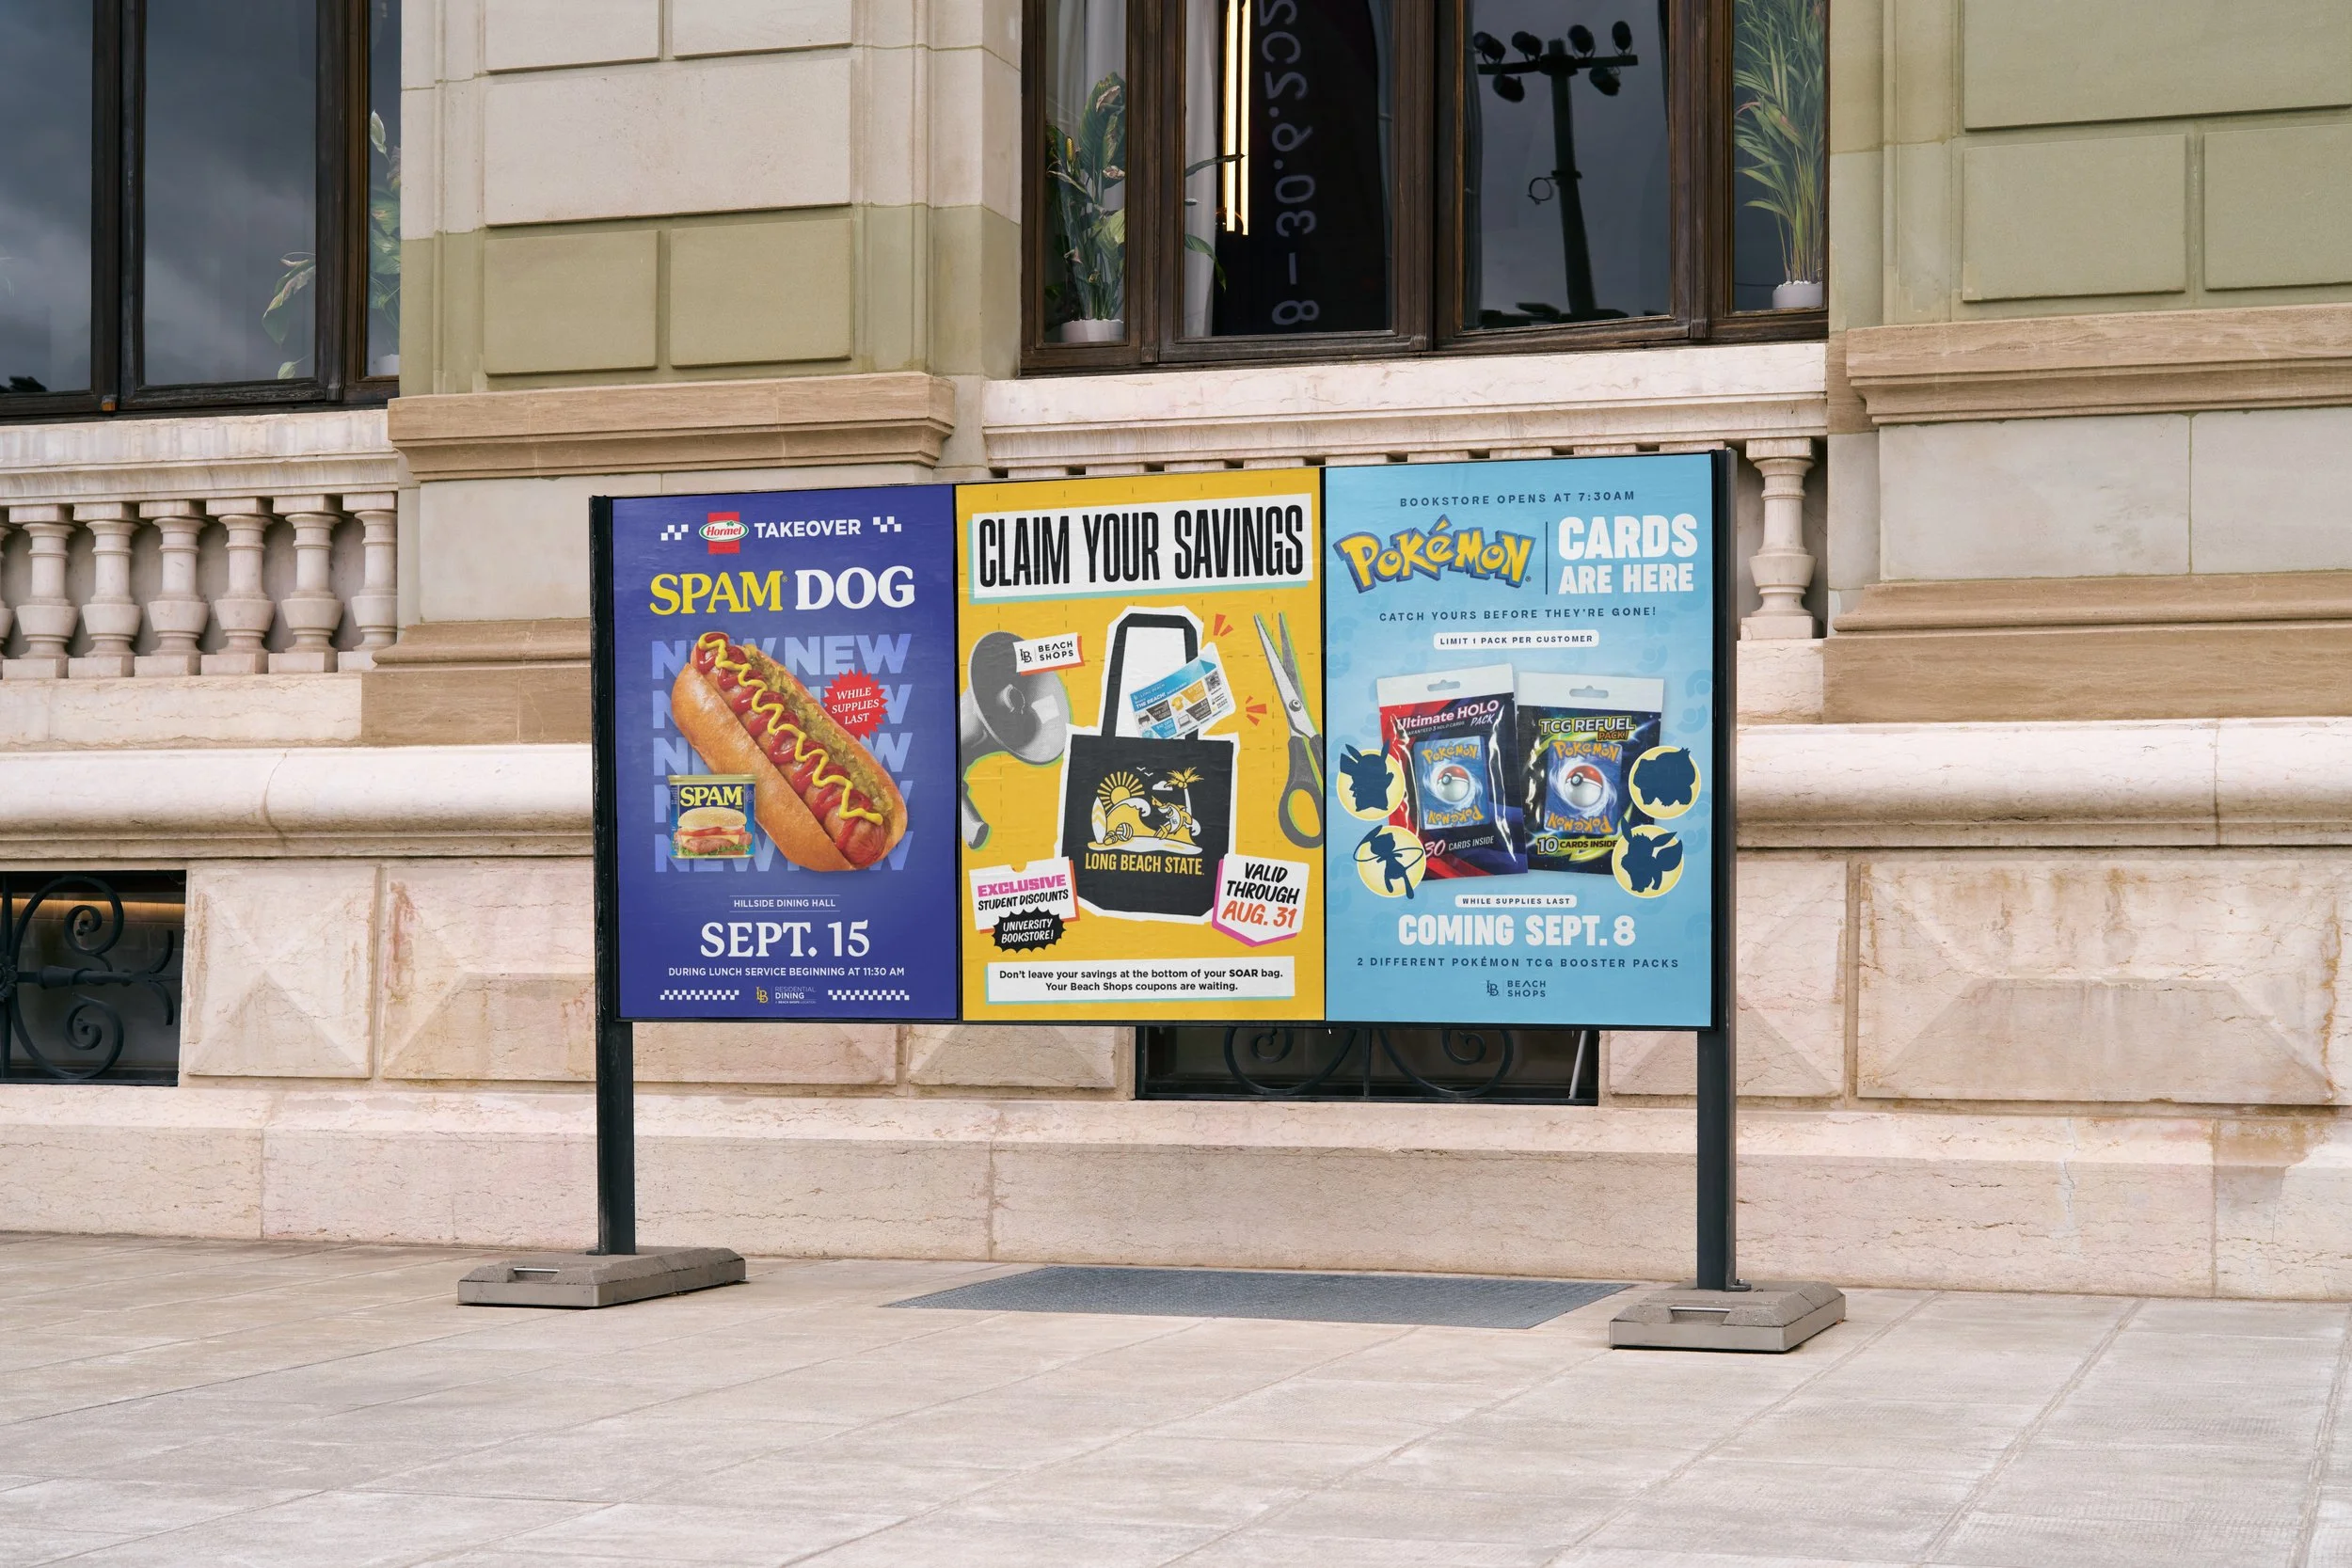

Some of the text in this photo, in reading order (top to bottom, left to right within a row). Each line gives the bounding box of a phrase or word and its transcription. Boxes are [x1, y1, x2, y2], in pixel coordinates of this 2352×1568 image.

[1400, 490, 1634, 507] BOOKSTORE OPENS AT 7:30AM
[707, 519, 861, 539] Hormel TAKEOVER
[1558, 513, 1698, 561] CARDS
[979, 504, 1303, 588] CLAIM YOUR SAVINGS
[1558, 562, 1694, 594] ARE HERE
[795, 565, 915, 610] DOG
[1379, 612, 1424, 622] CATCH
[1431, 610, 1477, 621] YOURS
[1484, 610, 1537, 620] BEFORE
[1612, 607, 1656, 617] GONE!
[785, 633, 912, 675] NEW
[1038, 641, 1073, 653] BEACH
[1040, 649, 1073, 661] SHOPS
[836, 687, 871, 700] WHILE
[831, 698, 880, 714] SUPPLIES
[844, 712, 870, 724] LAST
[1396, 700, 1500, 731] Ultimate HOLO
[1470, 714, 1495, 726] PACK
[1540, 718, 1635, 734] TCG REFUEL
[1597, 731, 1629, 740] PACK!
[680, 785, 742, 807] SPAM
[1424, 835, 1494, 858] 30 CARDS INSIDE
[1537, 836, 1559, 854] 10
[1560, 840, 1588, 848] CARDS
[1085, 852, 1117, 871] LONG
[1120, 854, 1161, 873] BEACH
[1245, 862, 1288, 883] VALID
[977, 874, 1067, 897] EXCLUSIVE
[1226, 879, 1300, 905] THROUGH
[734, 898, 835, 908] HILLSIDE DINING HALL
[977, 889, 1069, 911] STUDENT DISCOUNTS
[1221, 899, 1297, 928] AUG. 31
[1002, 918, 1053, 932] UNIVERSITY
[1398, 913, 1636, 946] COMING SEPT. 8
[700, 919, 870, 958] SEPT. 15
[1001, 929, 1054, 943] BOOKSTORE!
[1357, 956, 1678, 968] 2 DIFFERENT POKÉMON TCG BOOSTER PACKS
[668, 967, 905, 976] DURING LUNCH SERVICE BEGINNING AT 11:30 AM
[1027, 970, 1054, 979] leave
[1057, 971, 1078, 980] your
[1081, 970, 1117, 980] savings
[1120, 970, 1130, 978] at
[1133, 969, 1149, 978] the
[1152, 969, 1187, 978] bottom
[1190, 969, 1201, 978] of
[1204, 970, 1227, 979] your
[1229, 969, 1258, 977] SOAR
[1261, 969, 1283, 979] bag.
[1045, 981, 1238, 992] Your Beach Shops coupons are waiting.
